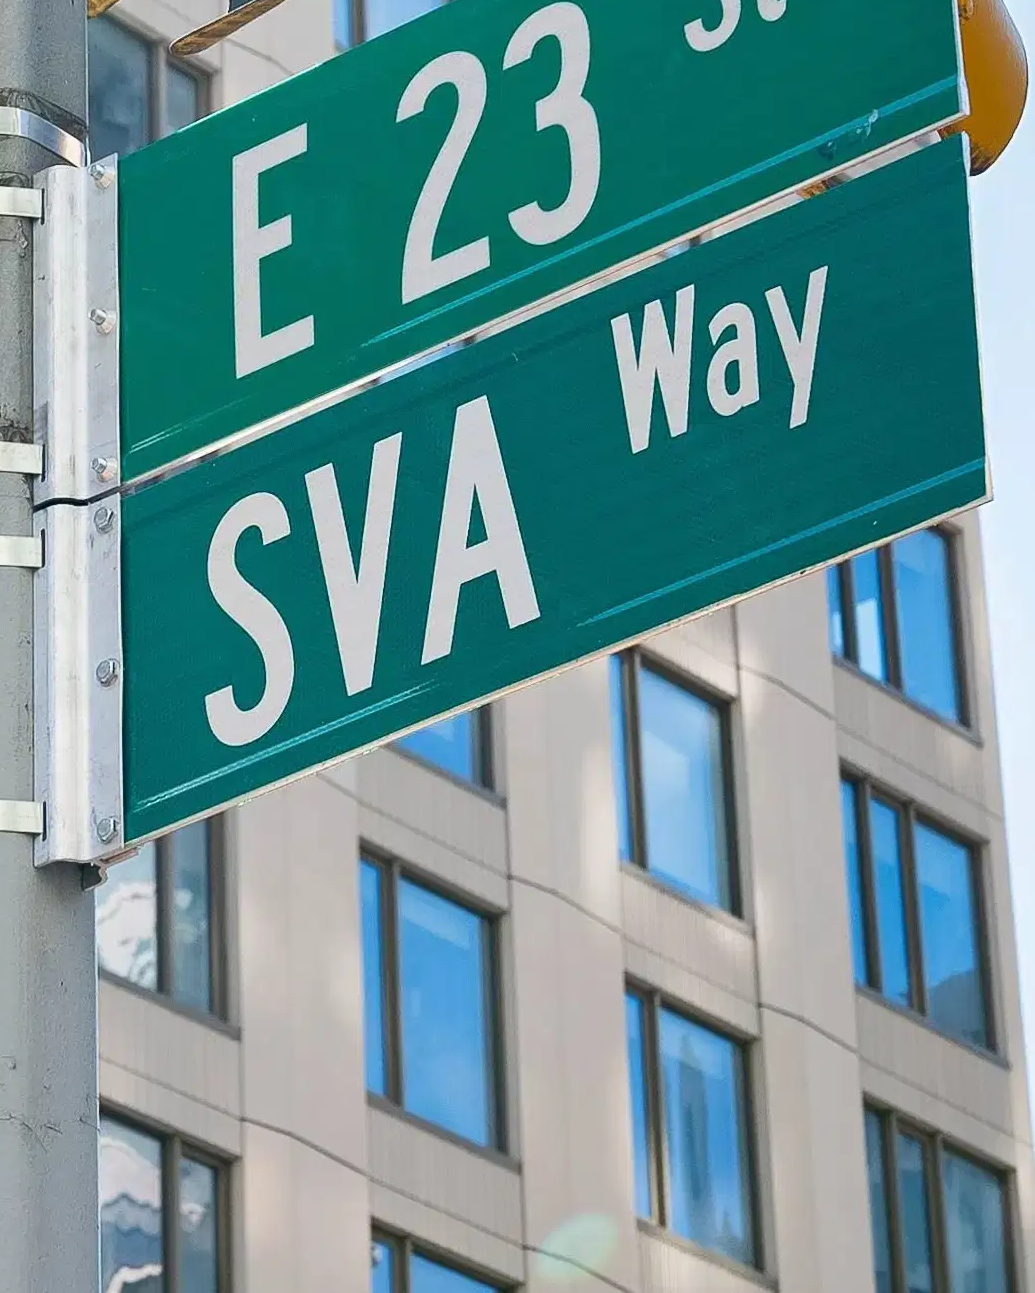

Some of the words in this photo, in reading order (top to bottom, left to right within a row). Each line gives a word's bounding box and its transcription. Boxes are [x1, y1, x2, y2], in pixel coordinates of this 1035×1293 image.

[231, 122, 315, 379] E
[395, 2, 602, 305] 23
[204, 395, 542, 748] SVA
[609, 265, 829, 454] Way
